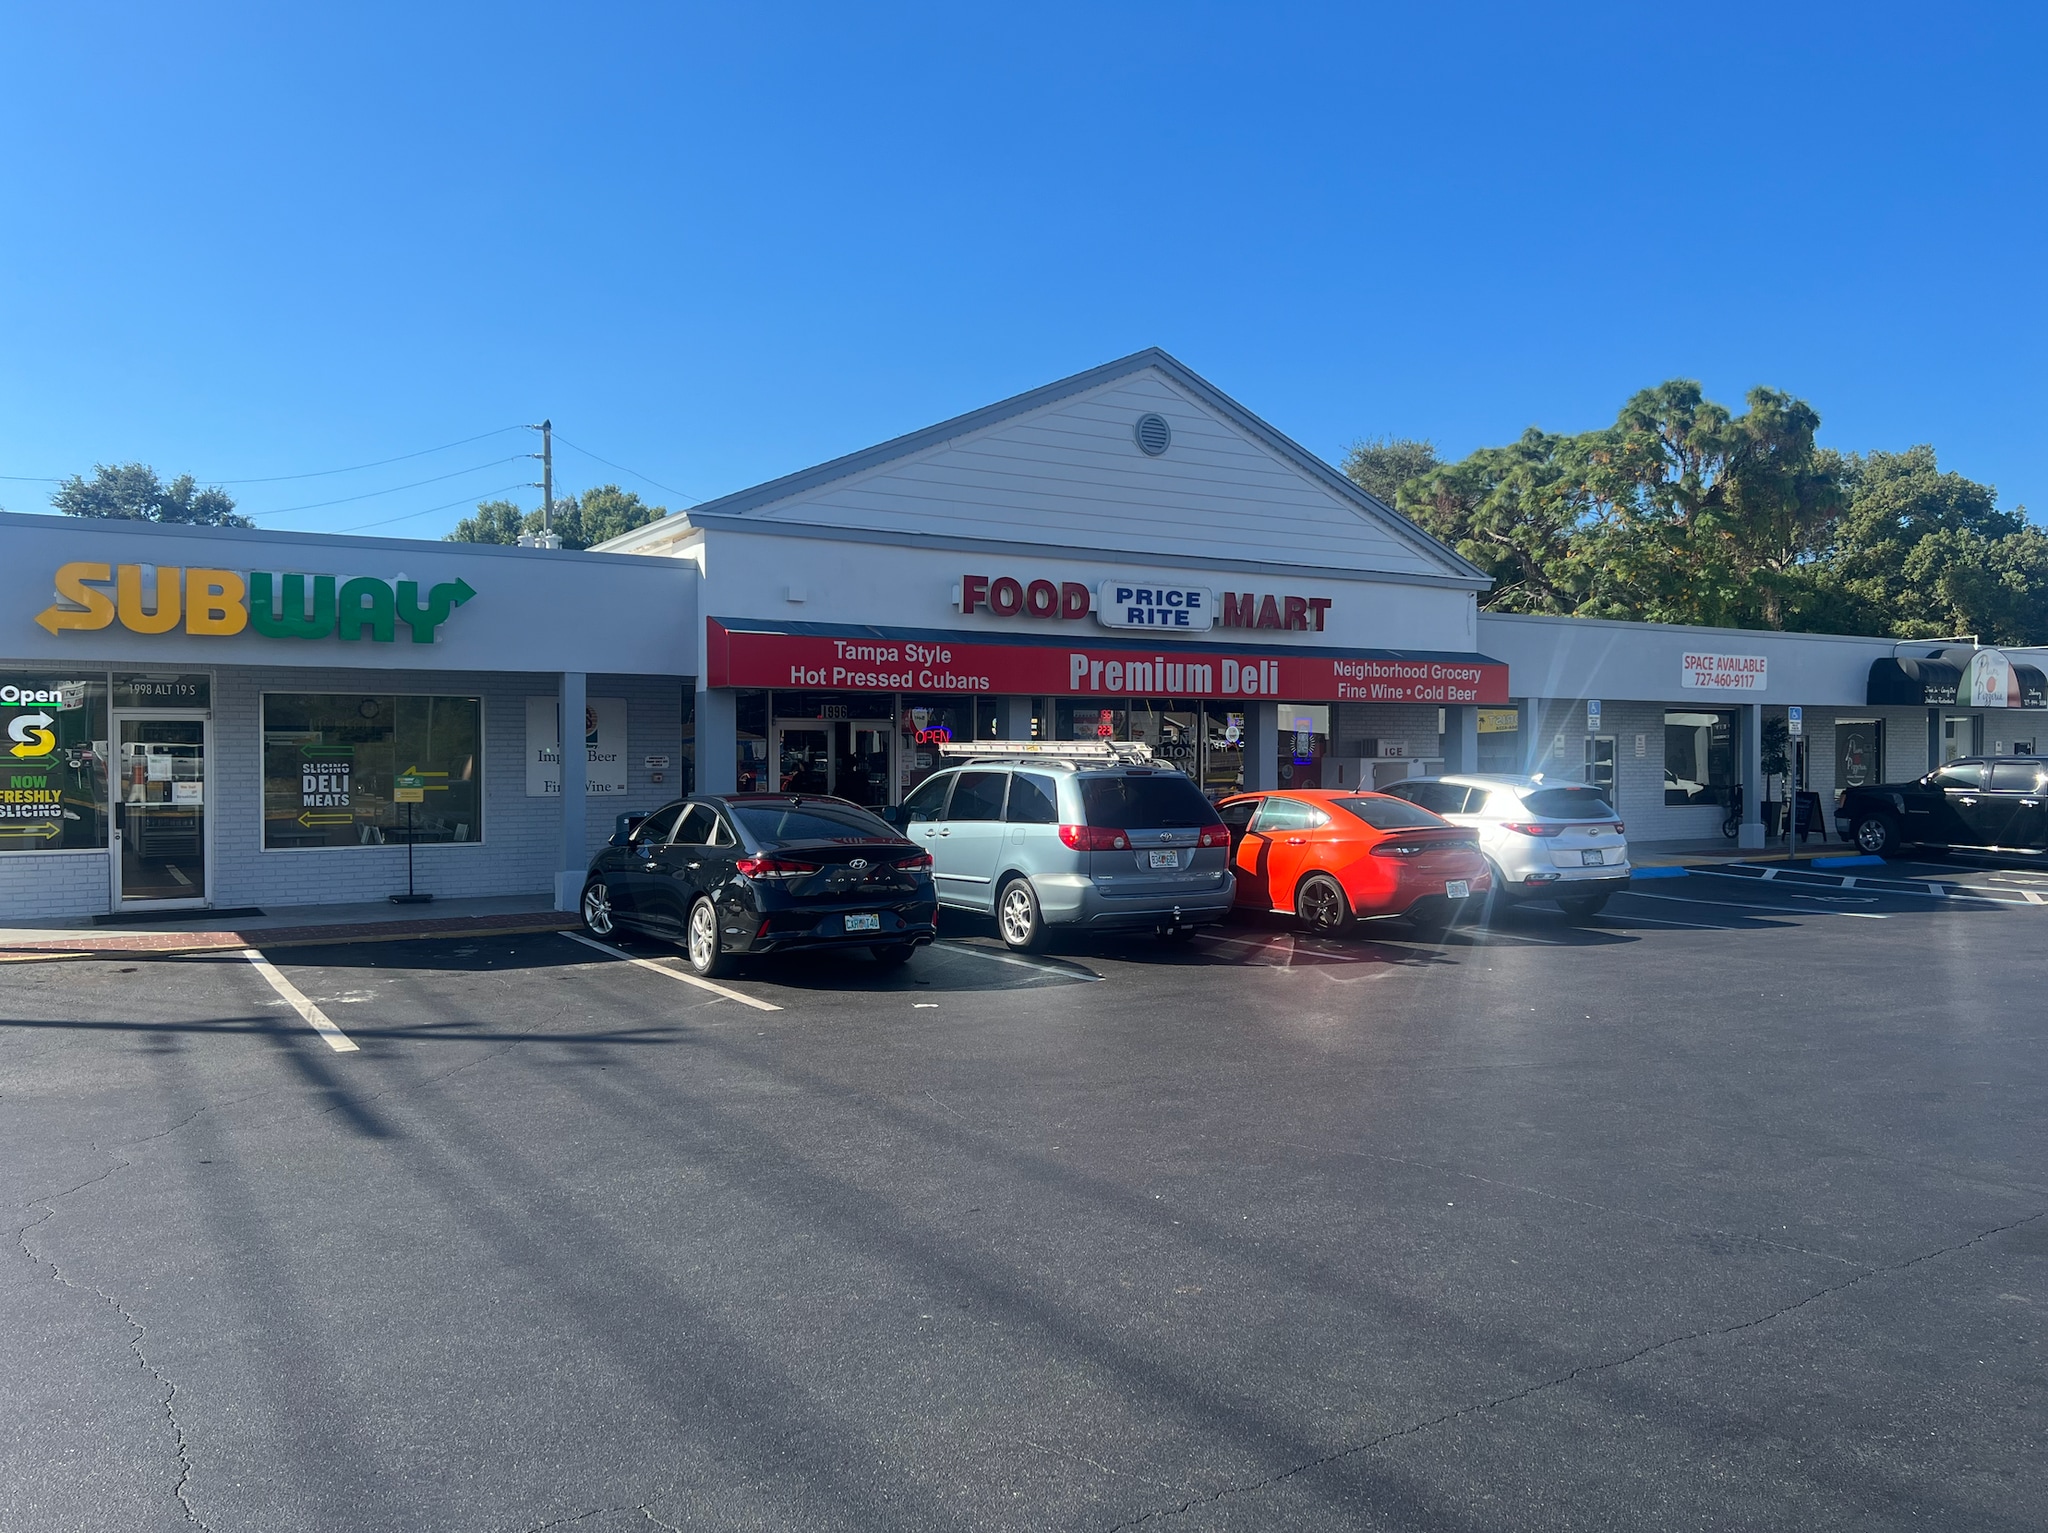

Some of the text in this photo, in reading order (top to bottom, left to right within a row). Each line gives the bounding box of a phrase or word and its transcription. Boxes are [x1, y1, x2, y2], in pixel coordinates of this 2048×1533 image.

[34, 561, 477, 644] SUBWAY
[960, 574, 1332, 632] FOOD MART
[1116, 587, 1201, 608] PRICE
[1127, 607, 1190, 626] RITE
[833, 640, 952, 667] Tampa Style
[1333, 661, 1481, 684] Neighborhood Grocery
[1684, 655, 1765, 673] SPACE AVAILABLE
[790, 666, 990, 690] Hot Pressed Cubans
[1069, 653, 1279, 694] Premium Deli
[1694, 672, 1755, 688] 727-460-9117
[0, 685, 62, 706] Open
[129, 683, 196, 696] 1998 ALT 19 S
[1337, 683, 1478, 701] Fine Wine Cold Beer
[822, 705, 847, 719] 1996
[915, 729, 949, 744] OPEN
[587, 750, 617, 762] Beer
[1385, 747, 1403, 756] ICE
[302, 763, 350, 774] SLICING
[10, 775, 48, 789] NOW
[302, 775, 350, 793] DELI
[303, 794, 350, 807] MEATS
[0, 804, 62, 818] SLICING
